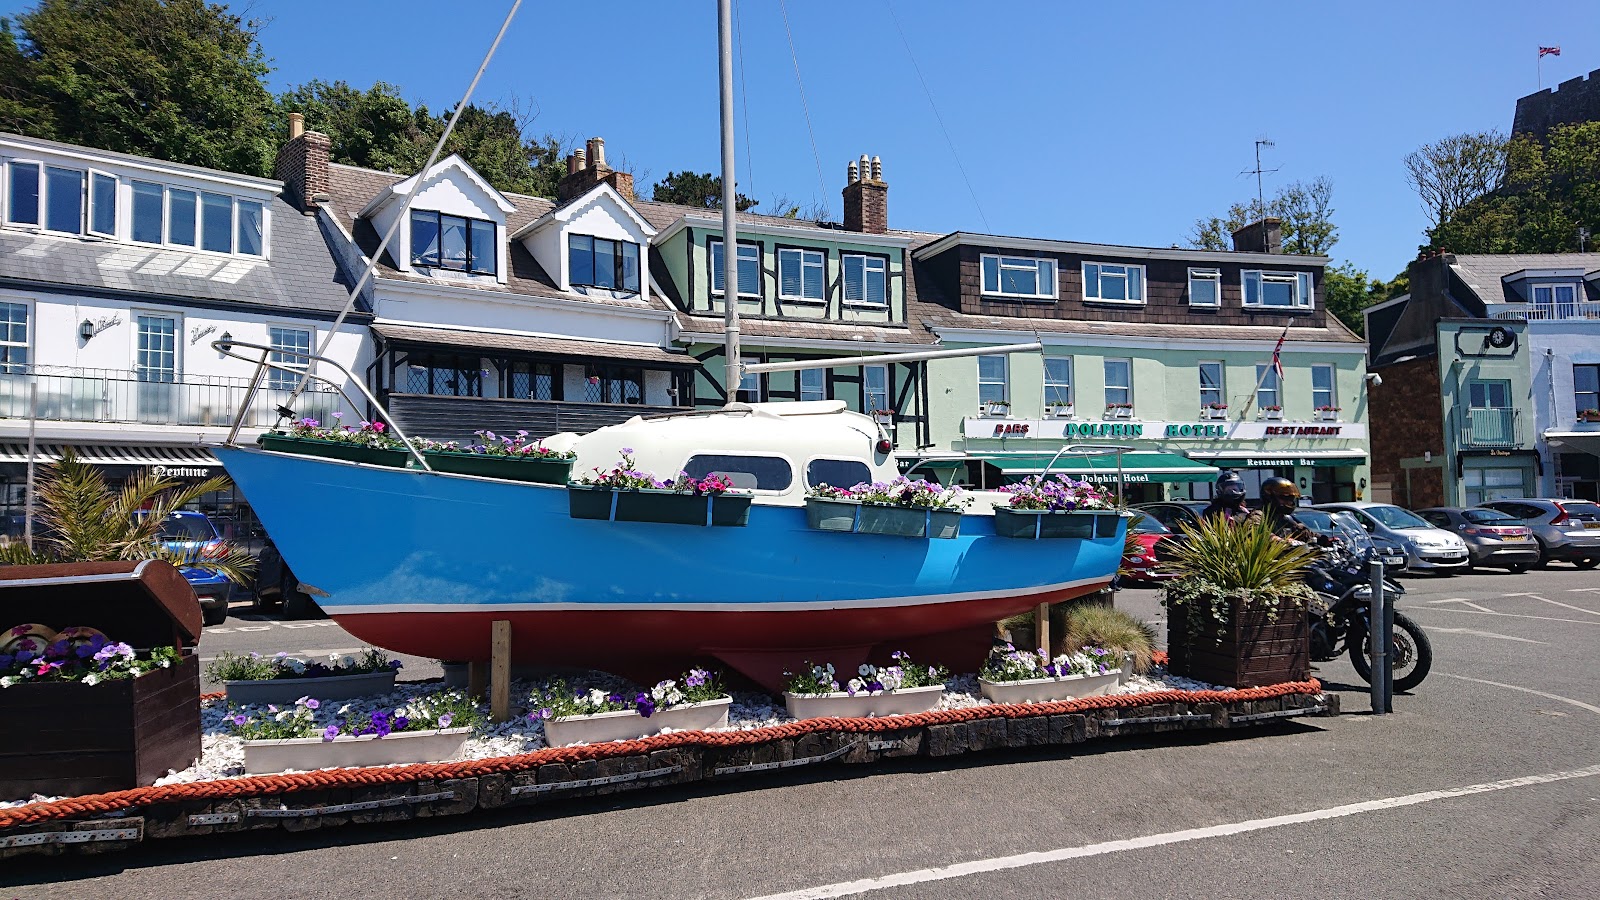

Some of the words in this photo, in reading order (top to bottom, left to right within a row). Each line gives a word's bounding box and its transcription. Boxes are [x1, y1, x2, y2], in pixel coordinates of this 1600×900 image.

[996, 424, 1029, 434] BARS
[1066, 423, 1143, 436] DOLPHIN
[1166, 425, 1228, 437] HOTEL
[1265, 426, 1342, 435] RESTAURANT
[1247, 458, 1294, 466] Restaurant
[1300, 458, 1316, 466] Bar
[151, 465, 208, 478] Neptune
[1081, 474, 1118, 484] Dolphin
[1123, 473, 1149, 482] Hotel
